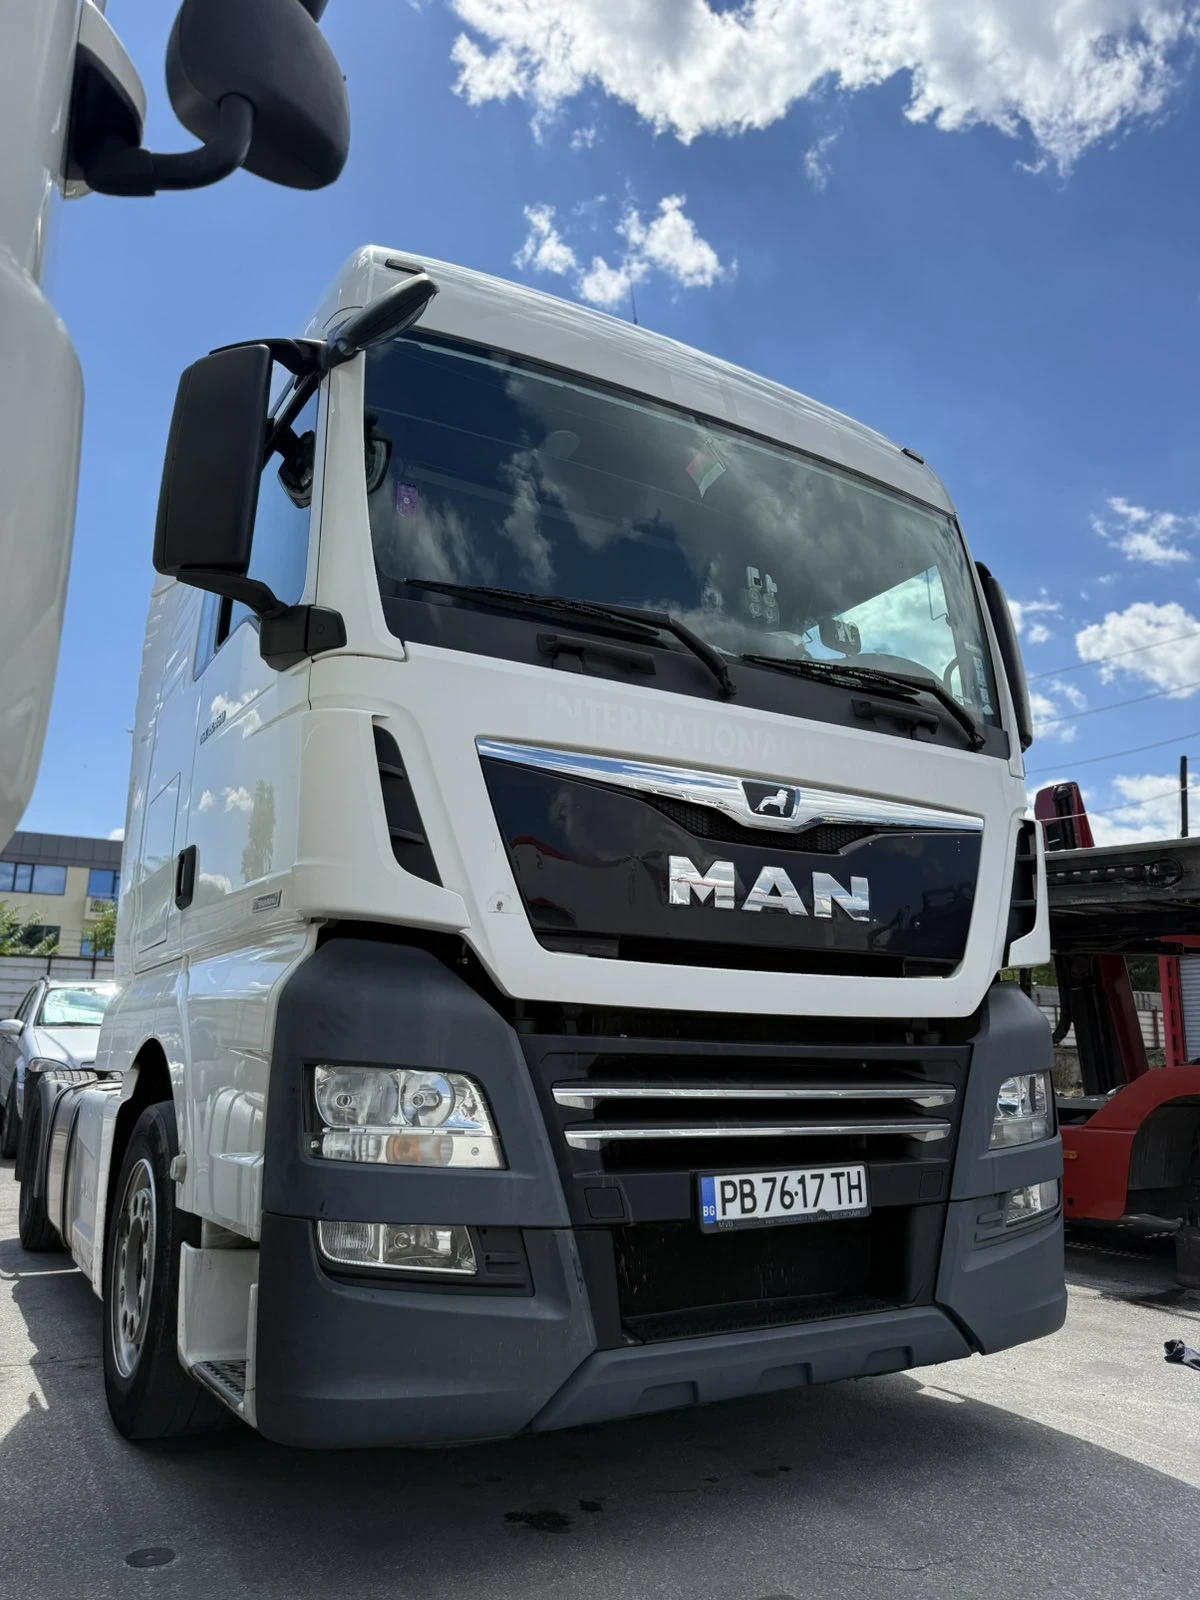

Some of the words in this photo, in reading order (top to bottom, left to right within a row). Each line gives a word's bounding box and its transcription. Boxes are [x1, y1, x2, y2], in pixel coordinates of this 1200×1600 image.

[669, 855, 870, 922] MAN
[702, 1205, 715, 1217] BG
[720, 1178, 758, 1217] PB
[761, 1174, 825, 1213] 7617
[830, 1170, 863, 1206] TH
